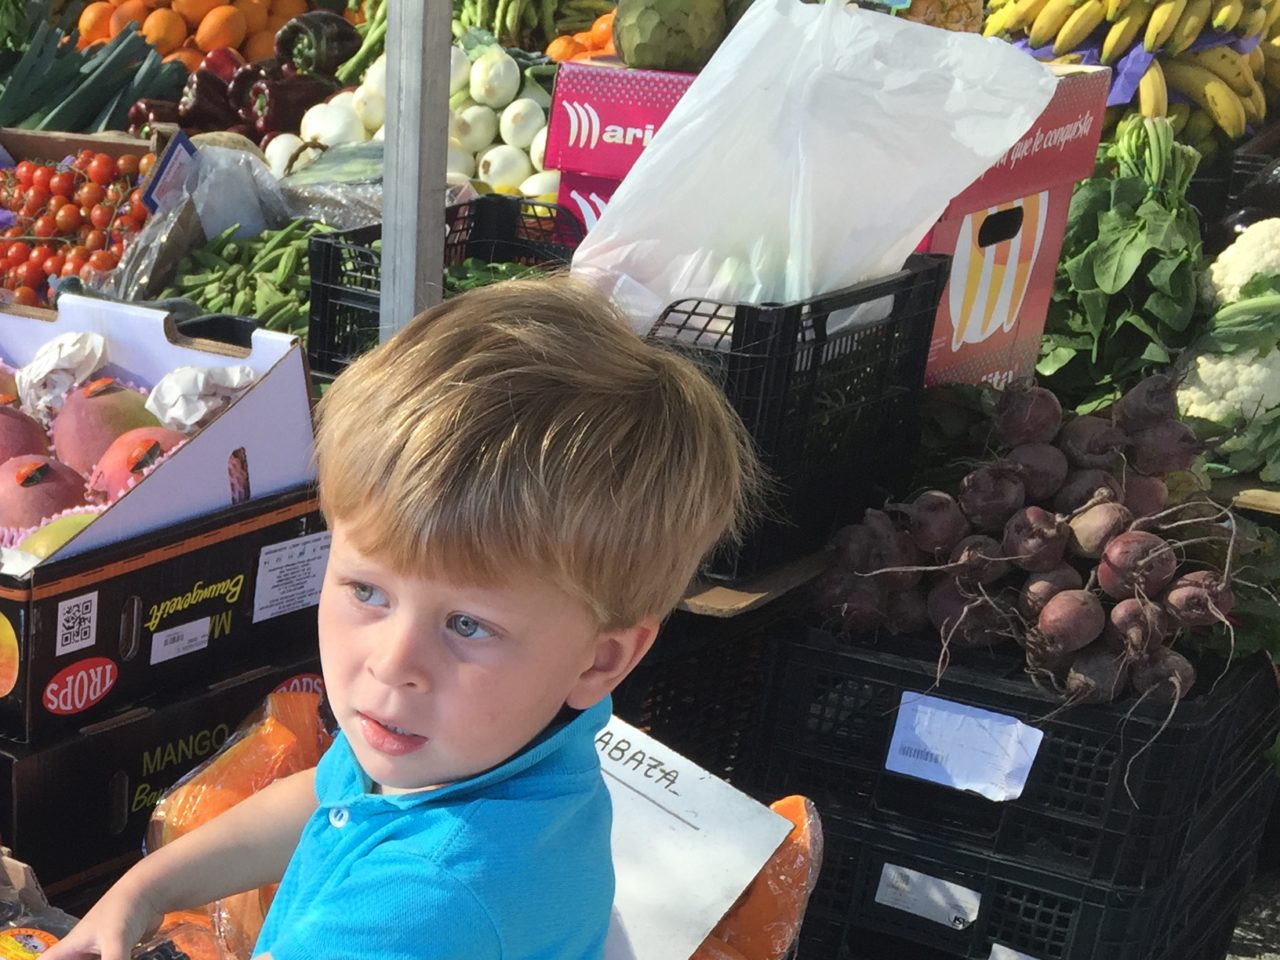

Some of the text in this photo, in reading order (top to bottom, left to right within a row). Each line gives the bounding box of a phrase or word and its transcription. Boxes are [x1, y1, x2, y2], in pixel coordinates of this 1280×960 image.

[46, 664, 112, 710] TROPS
[142, 723, 229, 776] MANGO
[594, 730, 679, 789] ABAZA
